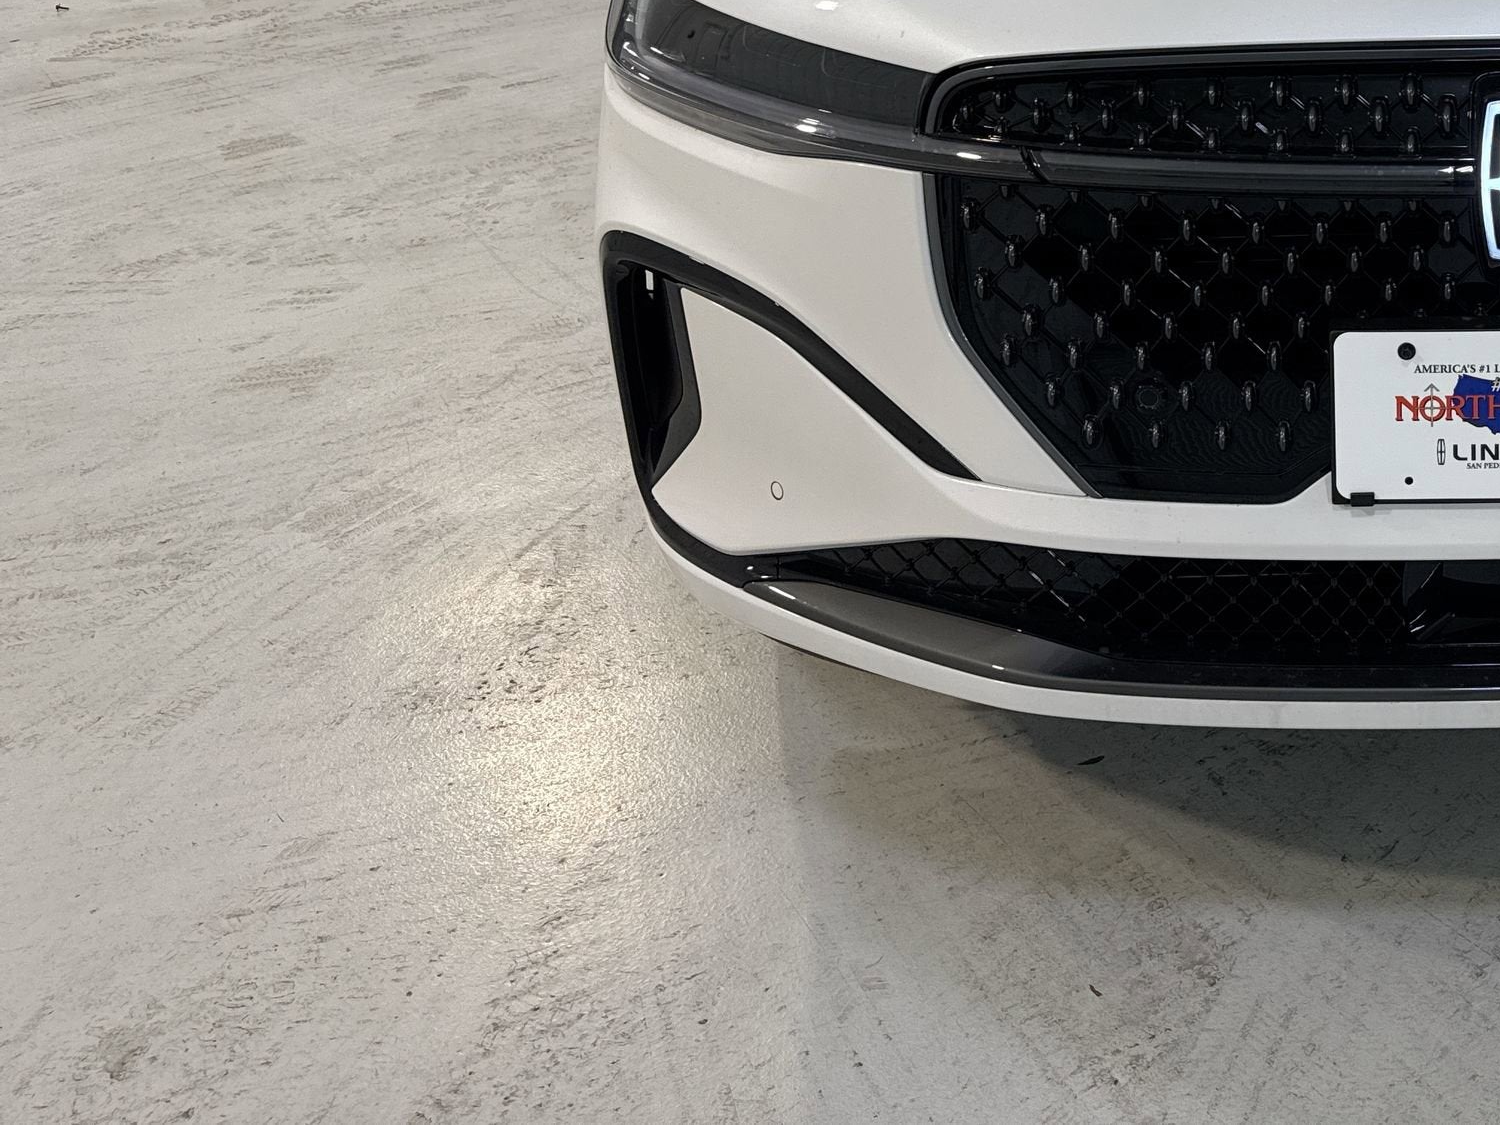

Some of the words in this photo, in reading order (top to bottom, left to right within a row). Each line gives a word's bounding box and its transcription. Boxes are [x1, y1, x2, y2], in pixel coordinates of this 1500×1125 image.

[1414, 363, 1477, 374] AMERICA'S
[1478, 363, 1491, 374] #1
[1466, 462, 1482, 470] SAN
